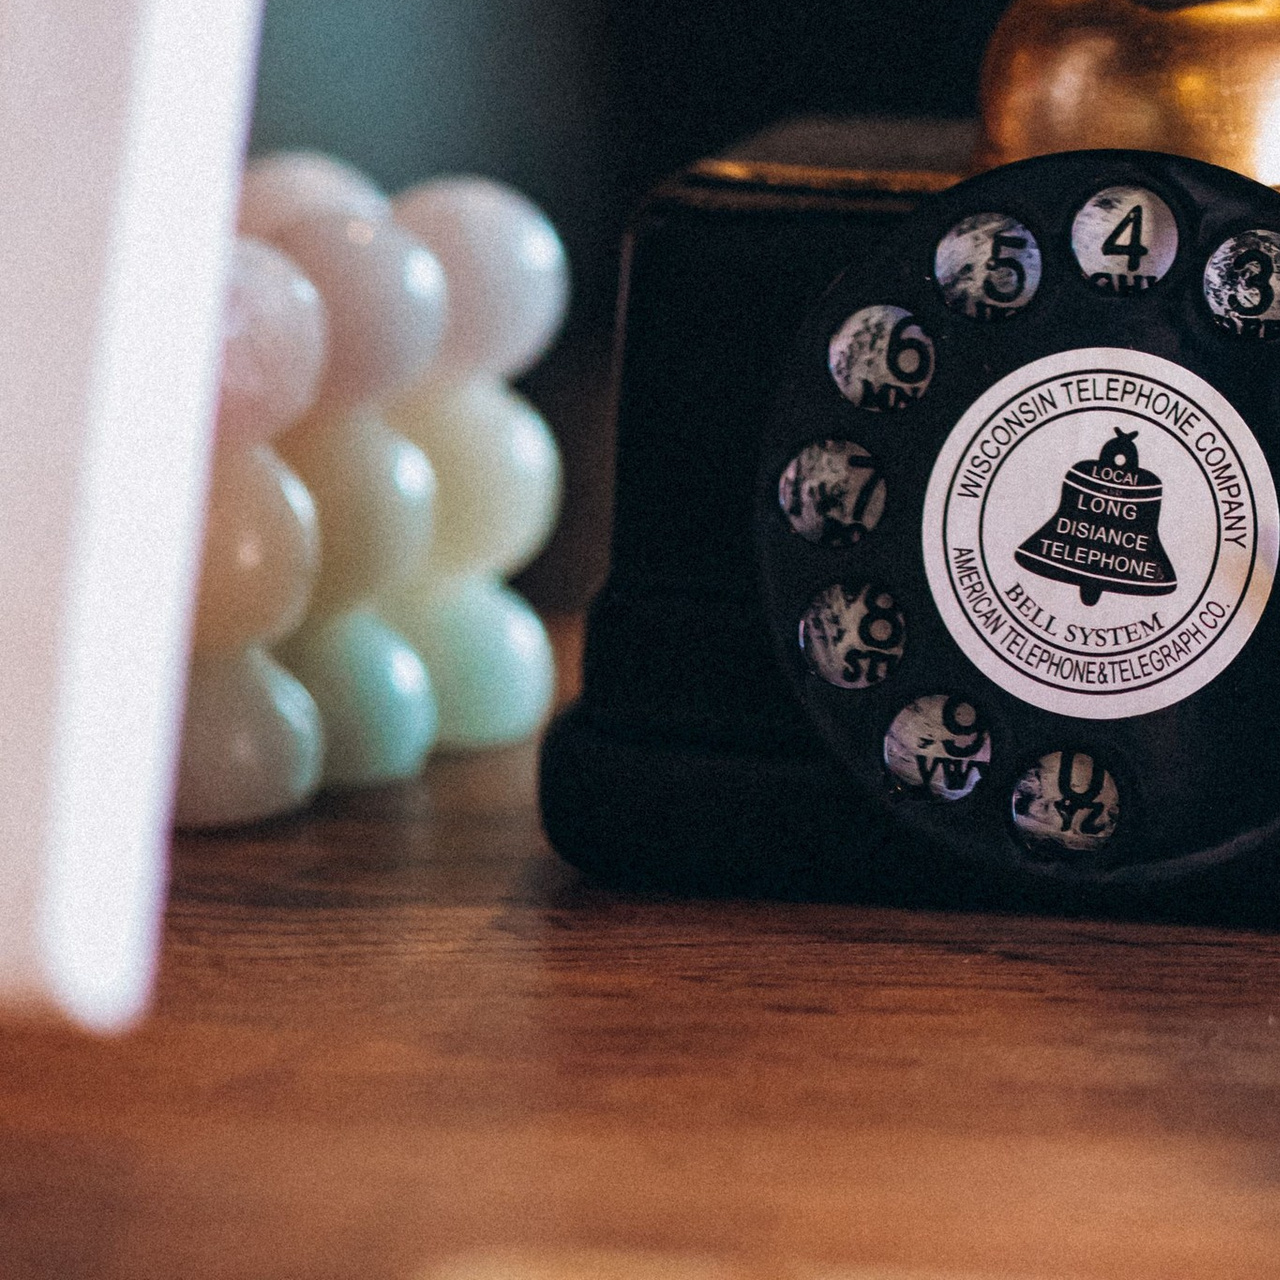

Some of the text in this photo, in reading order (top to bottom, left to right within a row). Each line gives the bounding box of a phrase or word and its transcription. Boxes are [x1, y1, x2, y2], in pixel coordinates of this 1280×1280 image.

[983, 231, 1027, 303] 5
[1101, 205, 1148, 272] 4
[1228, 248, 1274, 316] 3
[887, 314, 931, 384] 6
[957, 378, 1247, 550] WISCONSIN TELEPHONE COMPANY
[1077, 493, 1138, 520] LONG
[953, 547, 1008, 636] AMERICAN
[1199, 600, 1231, 630] CO.
[1040, 538, 1157, 579] TELEPHONE
[859, 584, 903, 650] 8
[1004, 582, 1166, 648] BELL SYSTEM
[942, 693, 987, 758] 9
